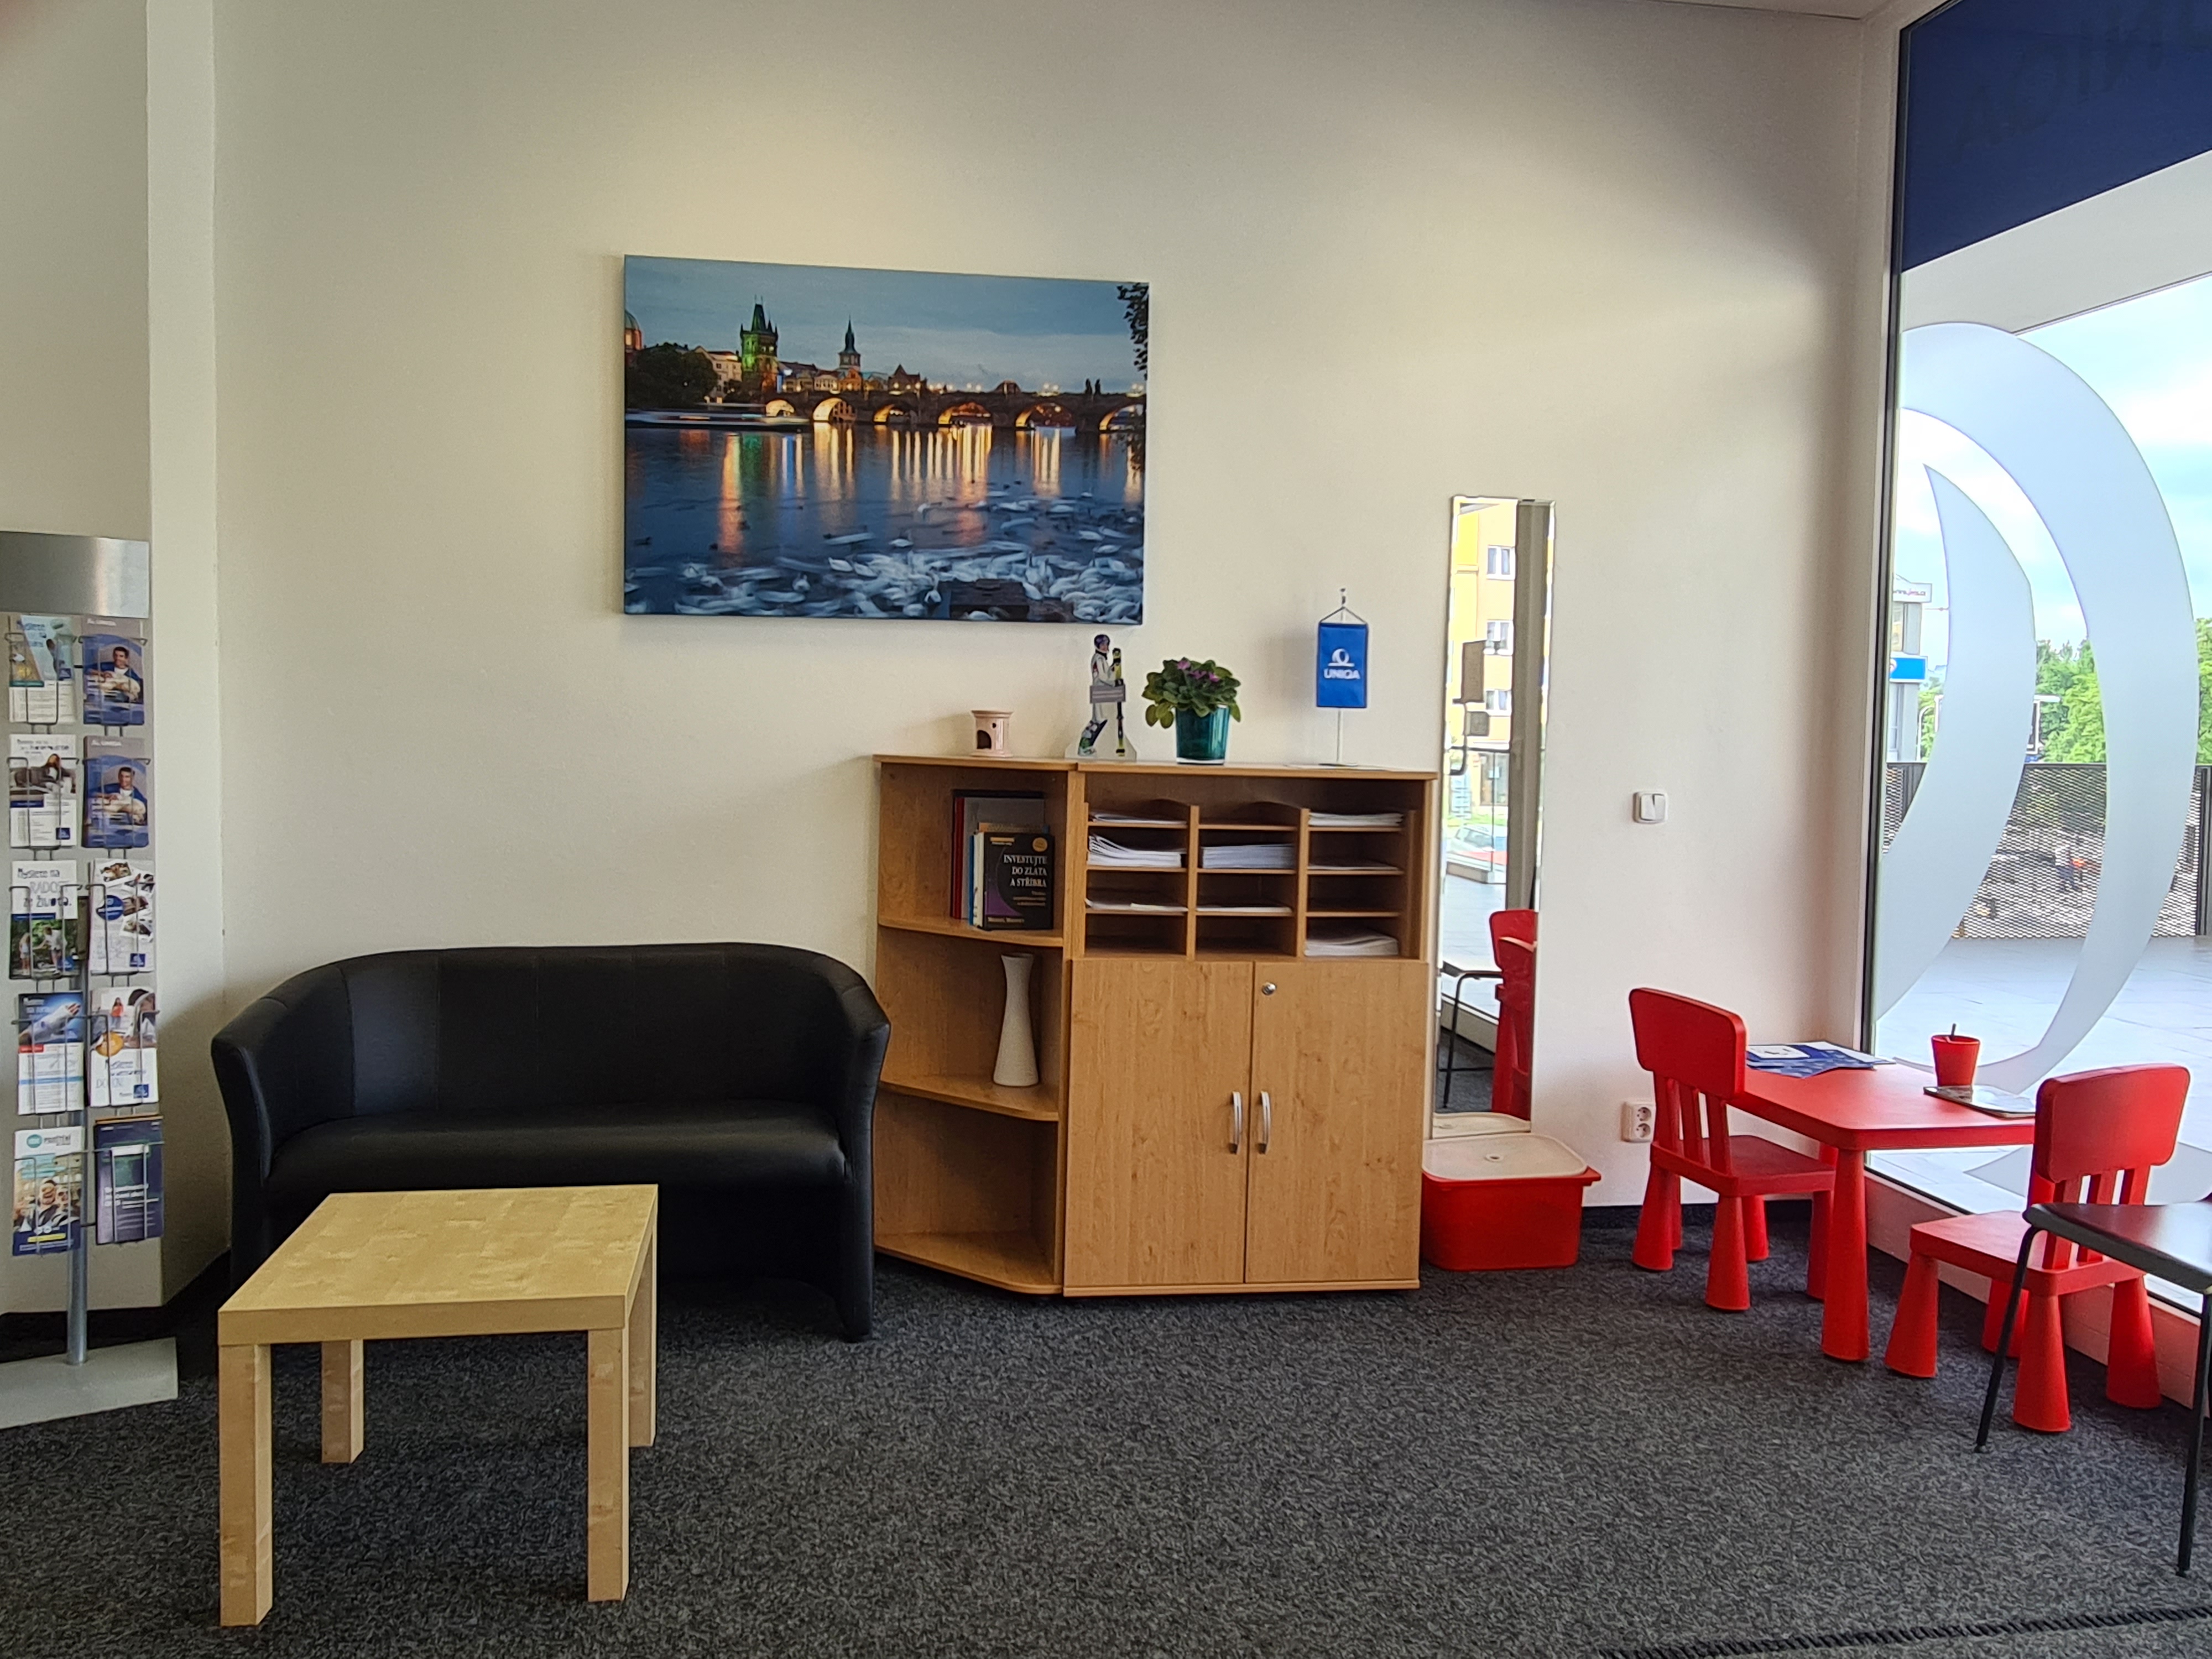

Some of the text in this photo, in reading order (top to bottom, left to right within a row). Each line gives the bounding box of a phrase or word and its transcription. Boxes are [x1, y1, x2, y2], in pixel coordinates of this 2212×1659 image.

[1324, 669, 1360, 679] UNIQA
[1004, 854, 1046, 867] INVESTUJTE
[1011, 867, 1047, 875] DO ZLATA
[1010, 877, 1047, 888] A STŘÍBRA
